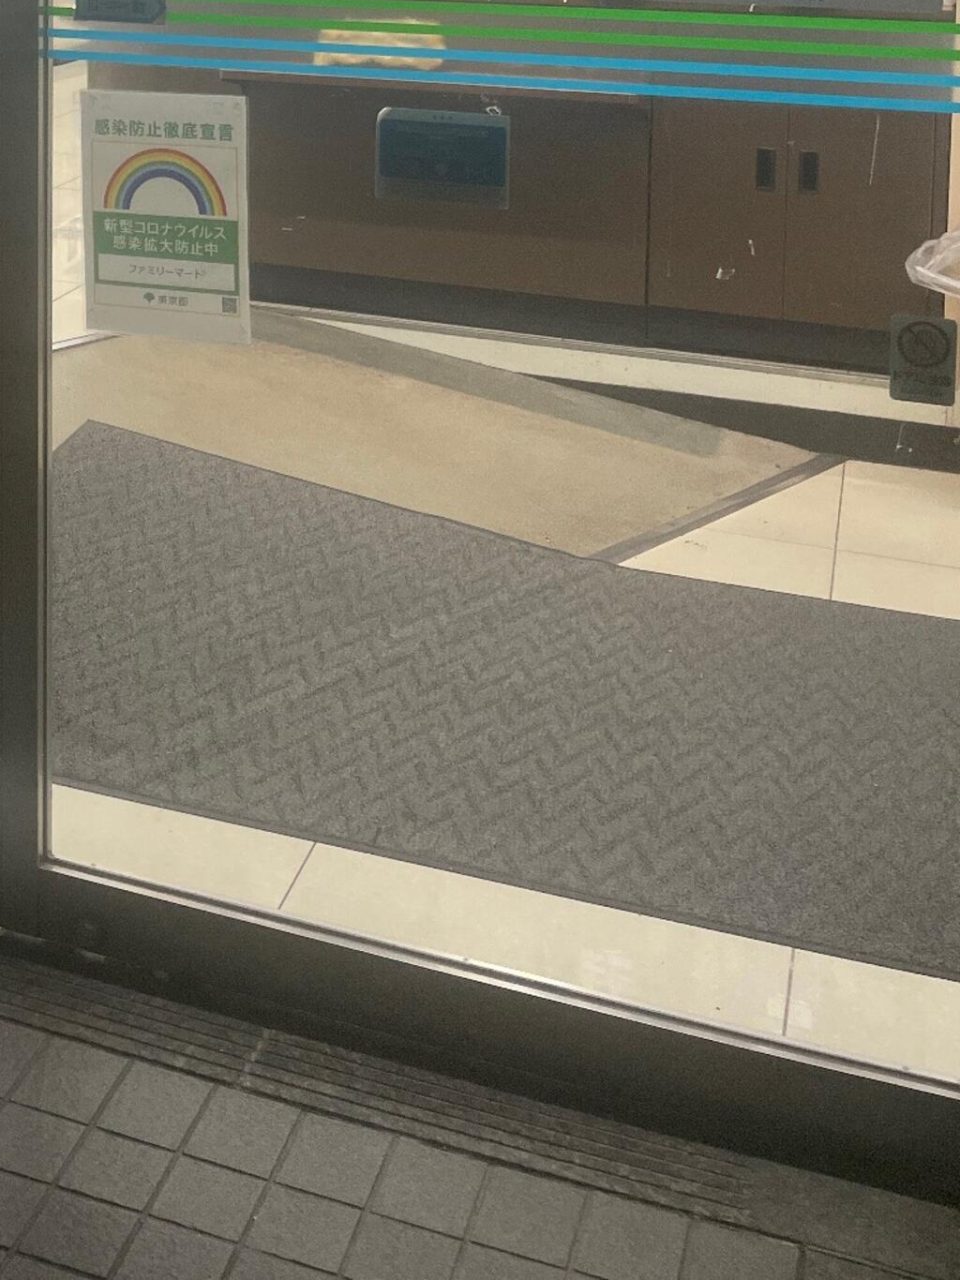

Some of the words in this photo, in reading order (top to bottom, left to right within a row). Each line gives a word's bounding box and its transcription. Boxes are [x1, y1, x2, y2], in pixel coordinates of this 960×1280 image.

[95, 118, 234, 142] 感染防止徹底宣言
[103, 217, 227, 241] 新型コロナウイルス
[112, 234, 218, 257] 感染拡大防止中
